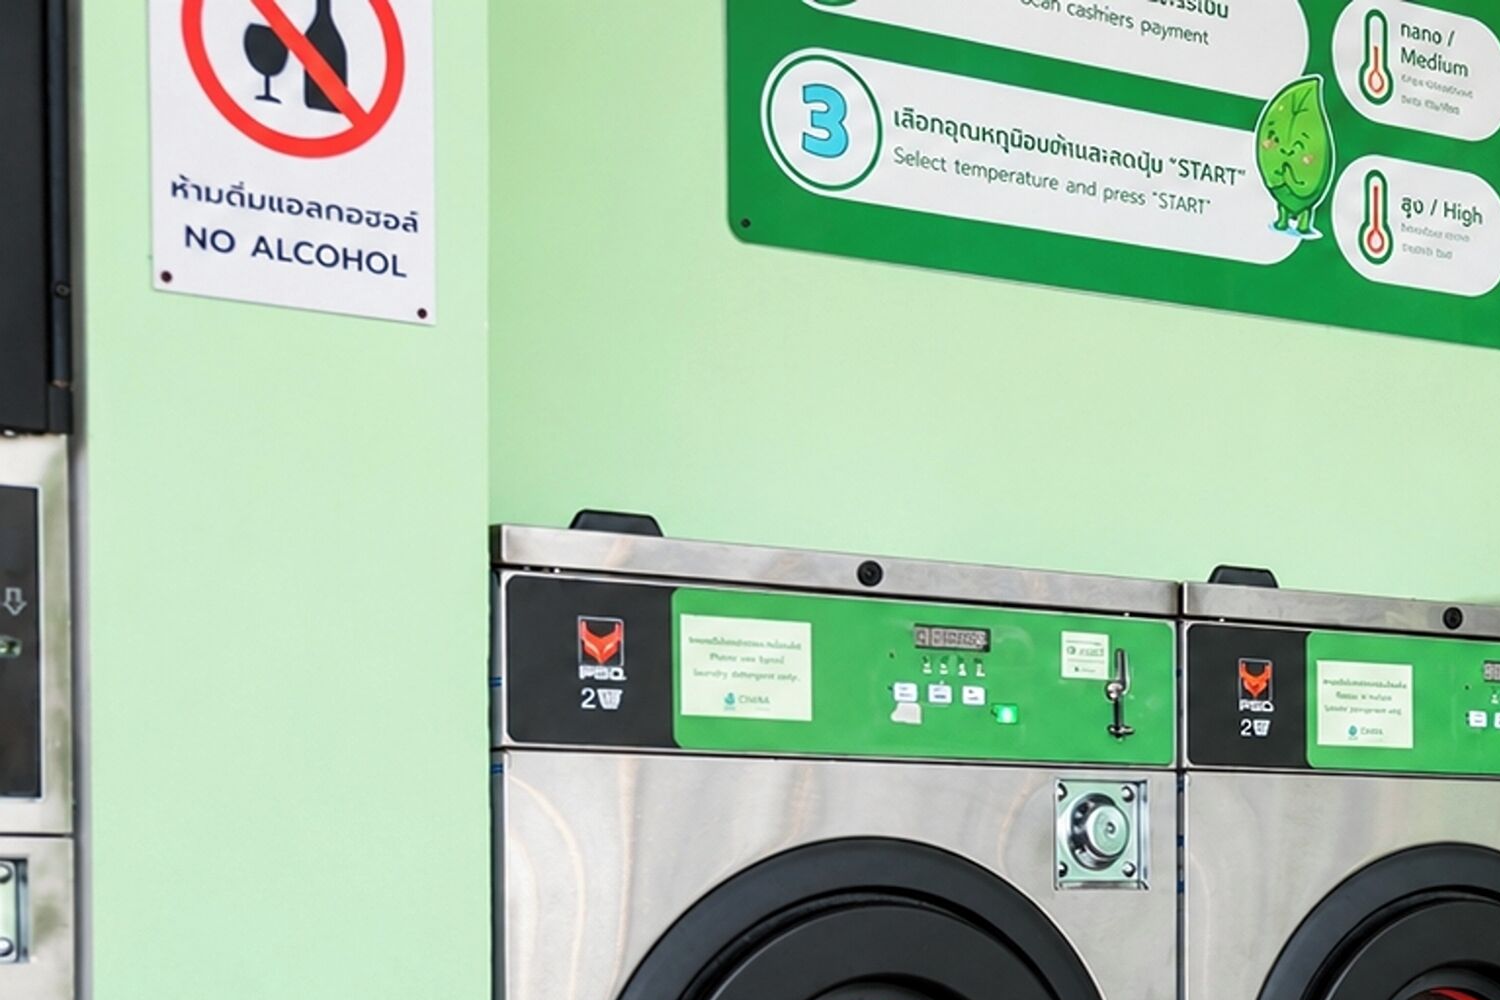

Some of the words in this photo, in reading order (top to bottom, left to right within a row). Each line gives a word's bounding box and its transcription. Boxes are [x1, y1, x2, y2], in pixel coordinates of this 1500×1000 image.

[1140, 19, 1210, 45] payment
[1400, 46, 1469, 77] Medium
[801, 82, 849, 159] 3
[893, 146, 948, 173] Select
[953, 158, 1060, 191] temperature
[1065, 180, 1098, 197] and
[1102, 186, 1147, 207] press
[1443, 200, 1484, 228] High
[184, 224, 236, 254] NO
[251, 235, 408, 278] ALCOHOL
[581, 687, 597, 709] 2
[1240, 718, 1252, 737] 2
